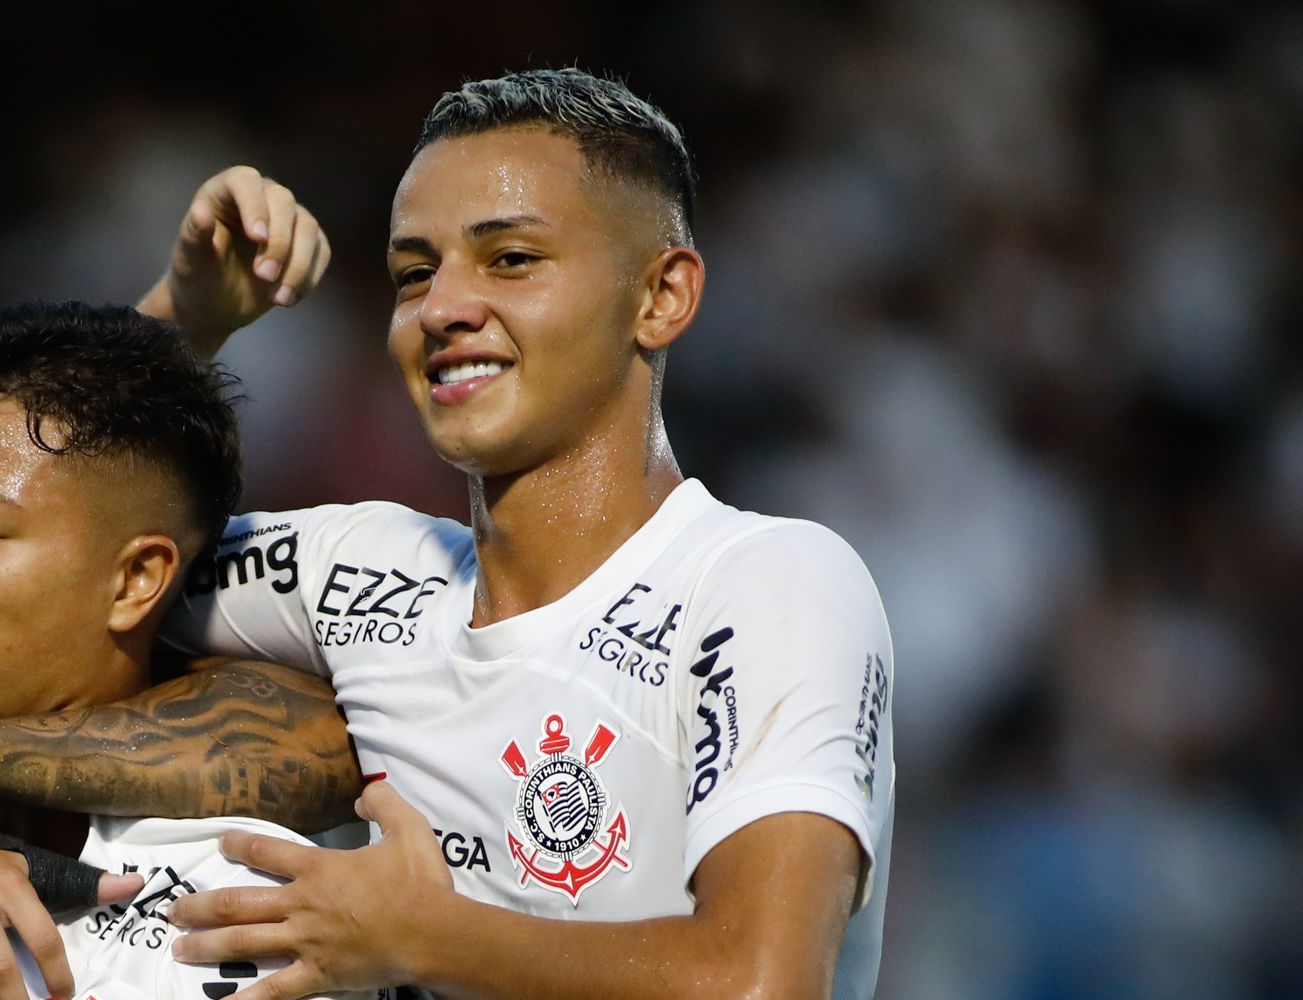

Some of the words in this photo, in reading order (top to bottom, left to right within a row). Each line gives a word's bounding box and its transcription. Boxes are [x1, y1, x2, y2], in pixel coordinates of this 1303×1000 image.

[316, 562, 449, 620] EZZE
[525, 762, 578, 818] CORINTHIANS
[577, 770, 599, 831] PAULISTA
[554, 839, 580, 851] 1910
